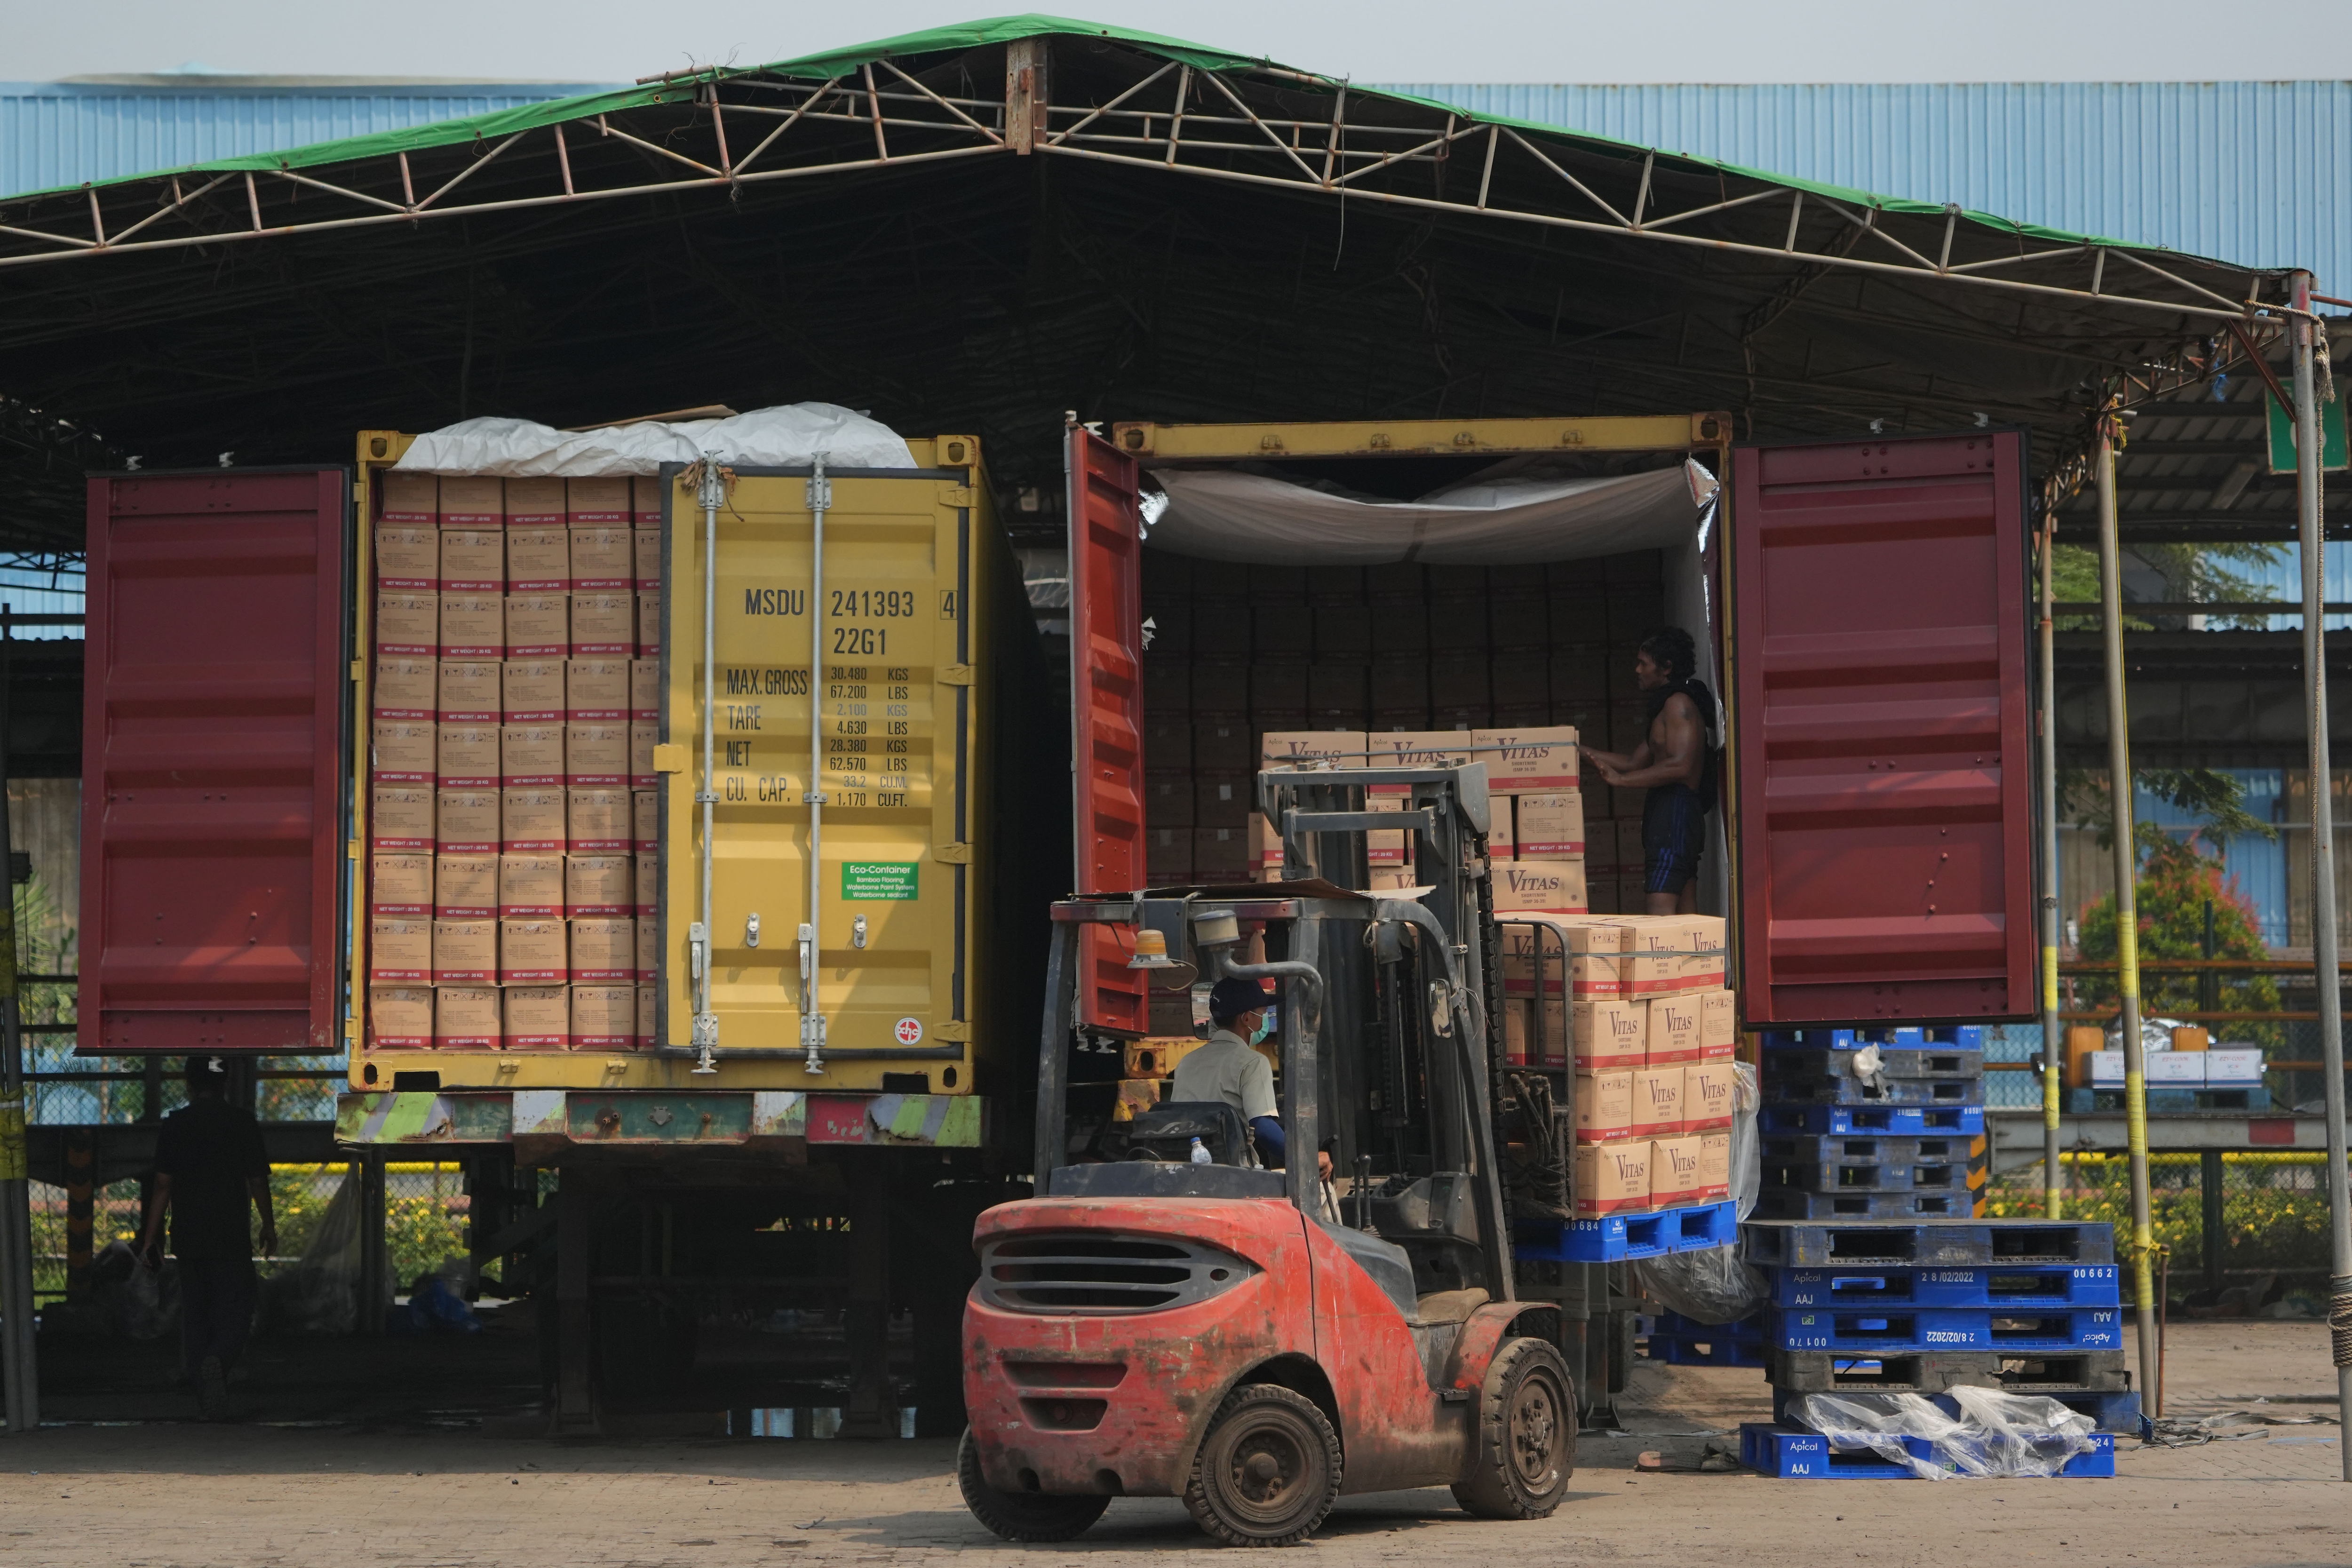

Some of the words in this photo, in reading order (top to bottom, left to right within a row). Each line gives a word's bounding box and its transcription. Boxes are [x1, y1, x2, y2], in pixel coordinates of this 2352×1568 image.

[746, 589, 804, 615] MSDU
[831, 590, 914, 617] 241393
[943, 592, 955, 618] 4
[834, 628, 886, 655] 22G1
[888, 668, 908, 681] KGS
[888, 686, 908, 700] LBS
[727, 705, 761, 730] TARE
[887, 705, 907, 716] KGS
[888, 722, 908, 735] LBS
[727, 741, 751, 766] NET
[887, 740, 907, 753] KGS
[1497, 738, 1550, 761] VITAS
[887, 758, 907, 772] LBS
[727, 777, 747, 802] CU.
[759, 777, 790, 802] CAP.
[844, 775, 866, 788] 33.2
[880, 776, 907, 788] CU.M.
[850, 865, 911, 874] Eco-Container
[1506, 870, 1559, 893] VITAS
[1609, 1011, 1637, 1037] VITAS
[1665, 1008, 1692, 1033] VITAS
[1649, 1080, 1676, 1106] VITAS
[1700, 1076, 1726, 1101] VITAS
[1616, 1155, 1644, 1181] VITAS
[1669, 1148, 1695, 1174] VITAS
[1794, 1272, 1820, 1284] Apical
[1796, 1295, 1813, 1305] AAJ
[2094, 1312, 2112, 1322] AAJ
[1790, 1440, 1818, 1453] Apical
[1791, 1464, 1809, 1474] AAJ
